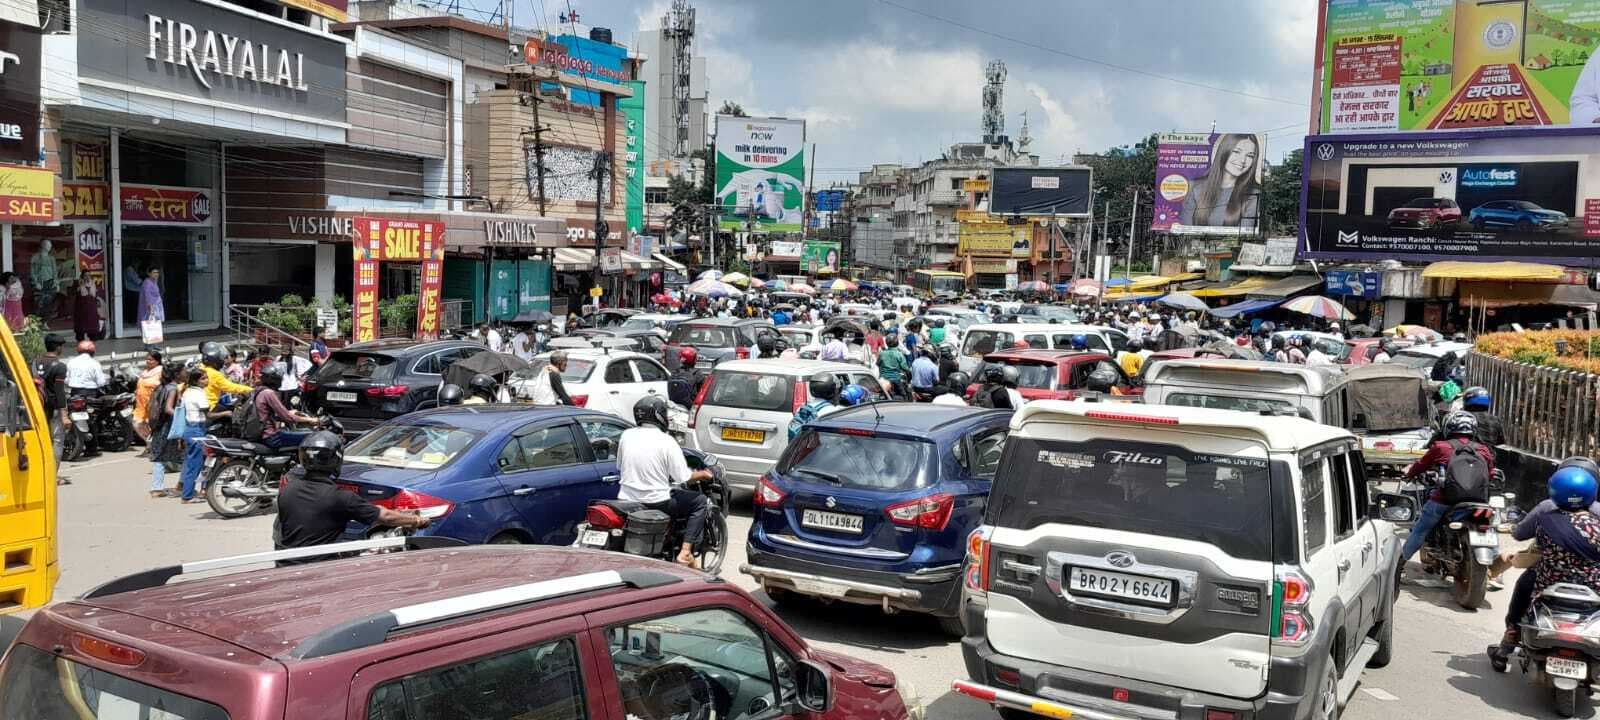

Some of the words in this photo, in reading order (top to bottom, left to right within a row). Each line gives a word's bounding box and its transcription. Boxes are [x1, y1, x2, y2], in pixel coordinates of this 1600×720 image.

[145, 14, 309, 91] FIRAYALAL
[1466, 83, 1522, 98] सरकार
[1362, 101, 1389, 110] सरकार
[1445, 97, 1502, 121] आपके
[1501, 99, 1535, 124] द्वार
[1344, 112, 1357, 122] रही
[1359, 111, 1380, 121] आपके
[1381, 112, 1394, 122] द्वार
[751, 132, 773, 140] now
[735, 144, 750, 152] milk
[752, 145, 787, 155] delivering
[1416, 142, 1469, 150] Volkswagen
[752, 155, 760, 163] 10
[1462, 168, 1517, 180] Autofest
[9, 200, 53, 217] SALE
[144, 189, 188, 219] सेल
[194, 199, 210, 215] SALE
[486, 220, 537, 243] VISHNEES
[80, 233, 103, 250] SALE
[385, 228, 421, 259] SALE
[1362, 235, 1408, 244] Volkswagen
[1408, 236, 1437, 244] Ranchi:
[359, 290, 374, 342] SALE
[1103, 450, 1163, 465] Filza
